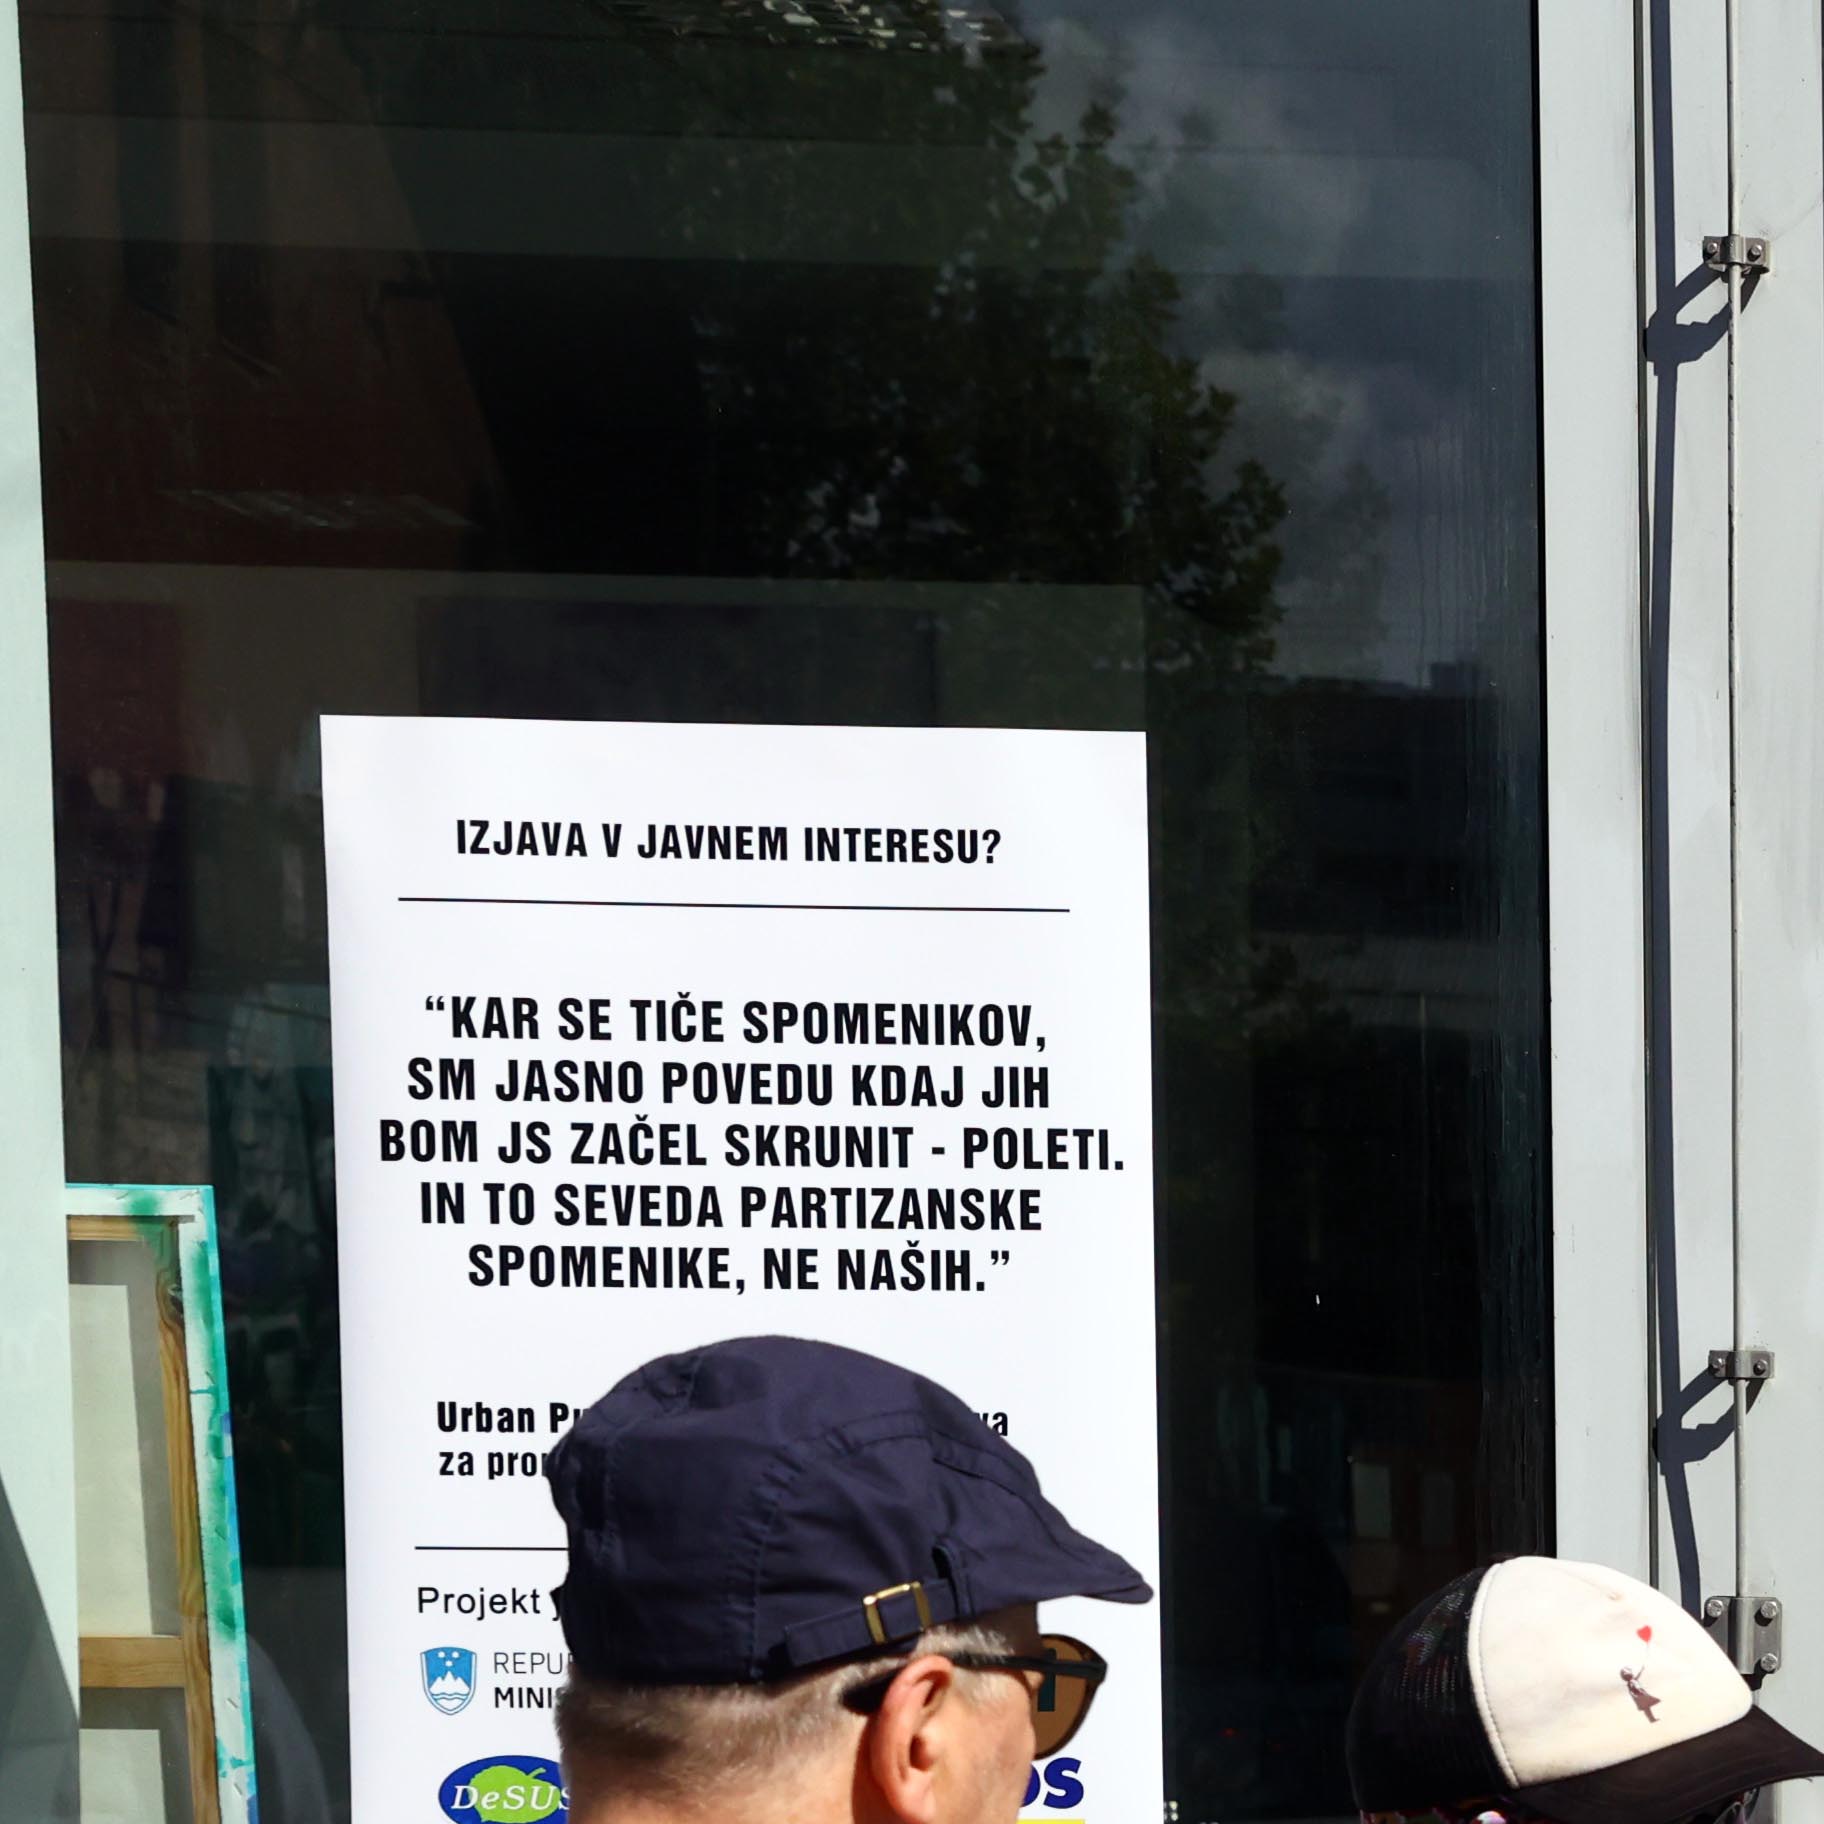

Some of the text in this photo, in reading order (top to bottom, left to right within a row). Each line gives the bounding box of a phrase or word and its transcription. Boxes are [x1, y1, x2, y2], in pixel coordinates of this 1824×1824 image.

[456, 819, 1002, 865] IZJAVA V JAVNEM INTERESU?
[557, 997, 613, 1041] SE
[629, 991, 725, 1043] TIČE
[742, 1000, 1046, 1053] SPOMENIKOV,
[407, 1056, 1050, 1109] SM JASNO POVEDU KDAJ JIH
[379, 1118, 479, 1163] BOM
[497, 1120, 552, 1165] JS
[569, 1113, 708, 1167] ZAČEL
[724, 1123, 914, 1169] SKRUNIT
[963, 1126, 1124, 1171] POLETI.
[420, 1181, 1042, 1232] IN TO SEVEDA PARTIZANSKE
[468, 1243, 746, 1296] SPOMENIKE,
[763, 1247, 820, 1291] NE
[436, 1400, 536, 1434] Urban
[438, 1451, 475, 1477] za
[417, 1586, 541, 1622] Projekt
